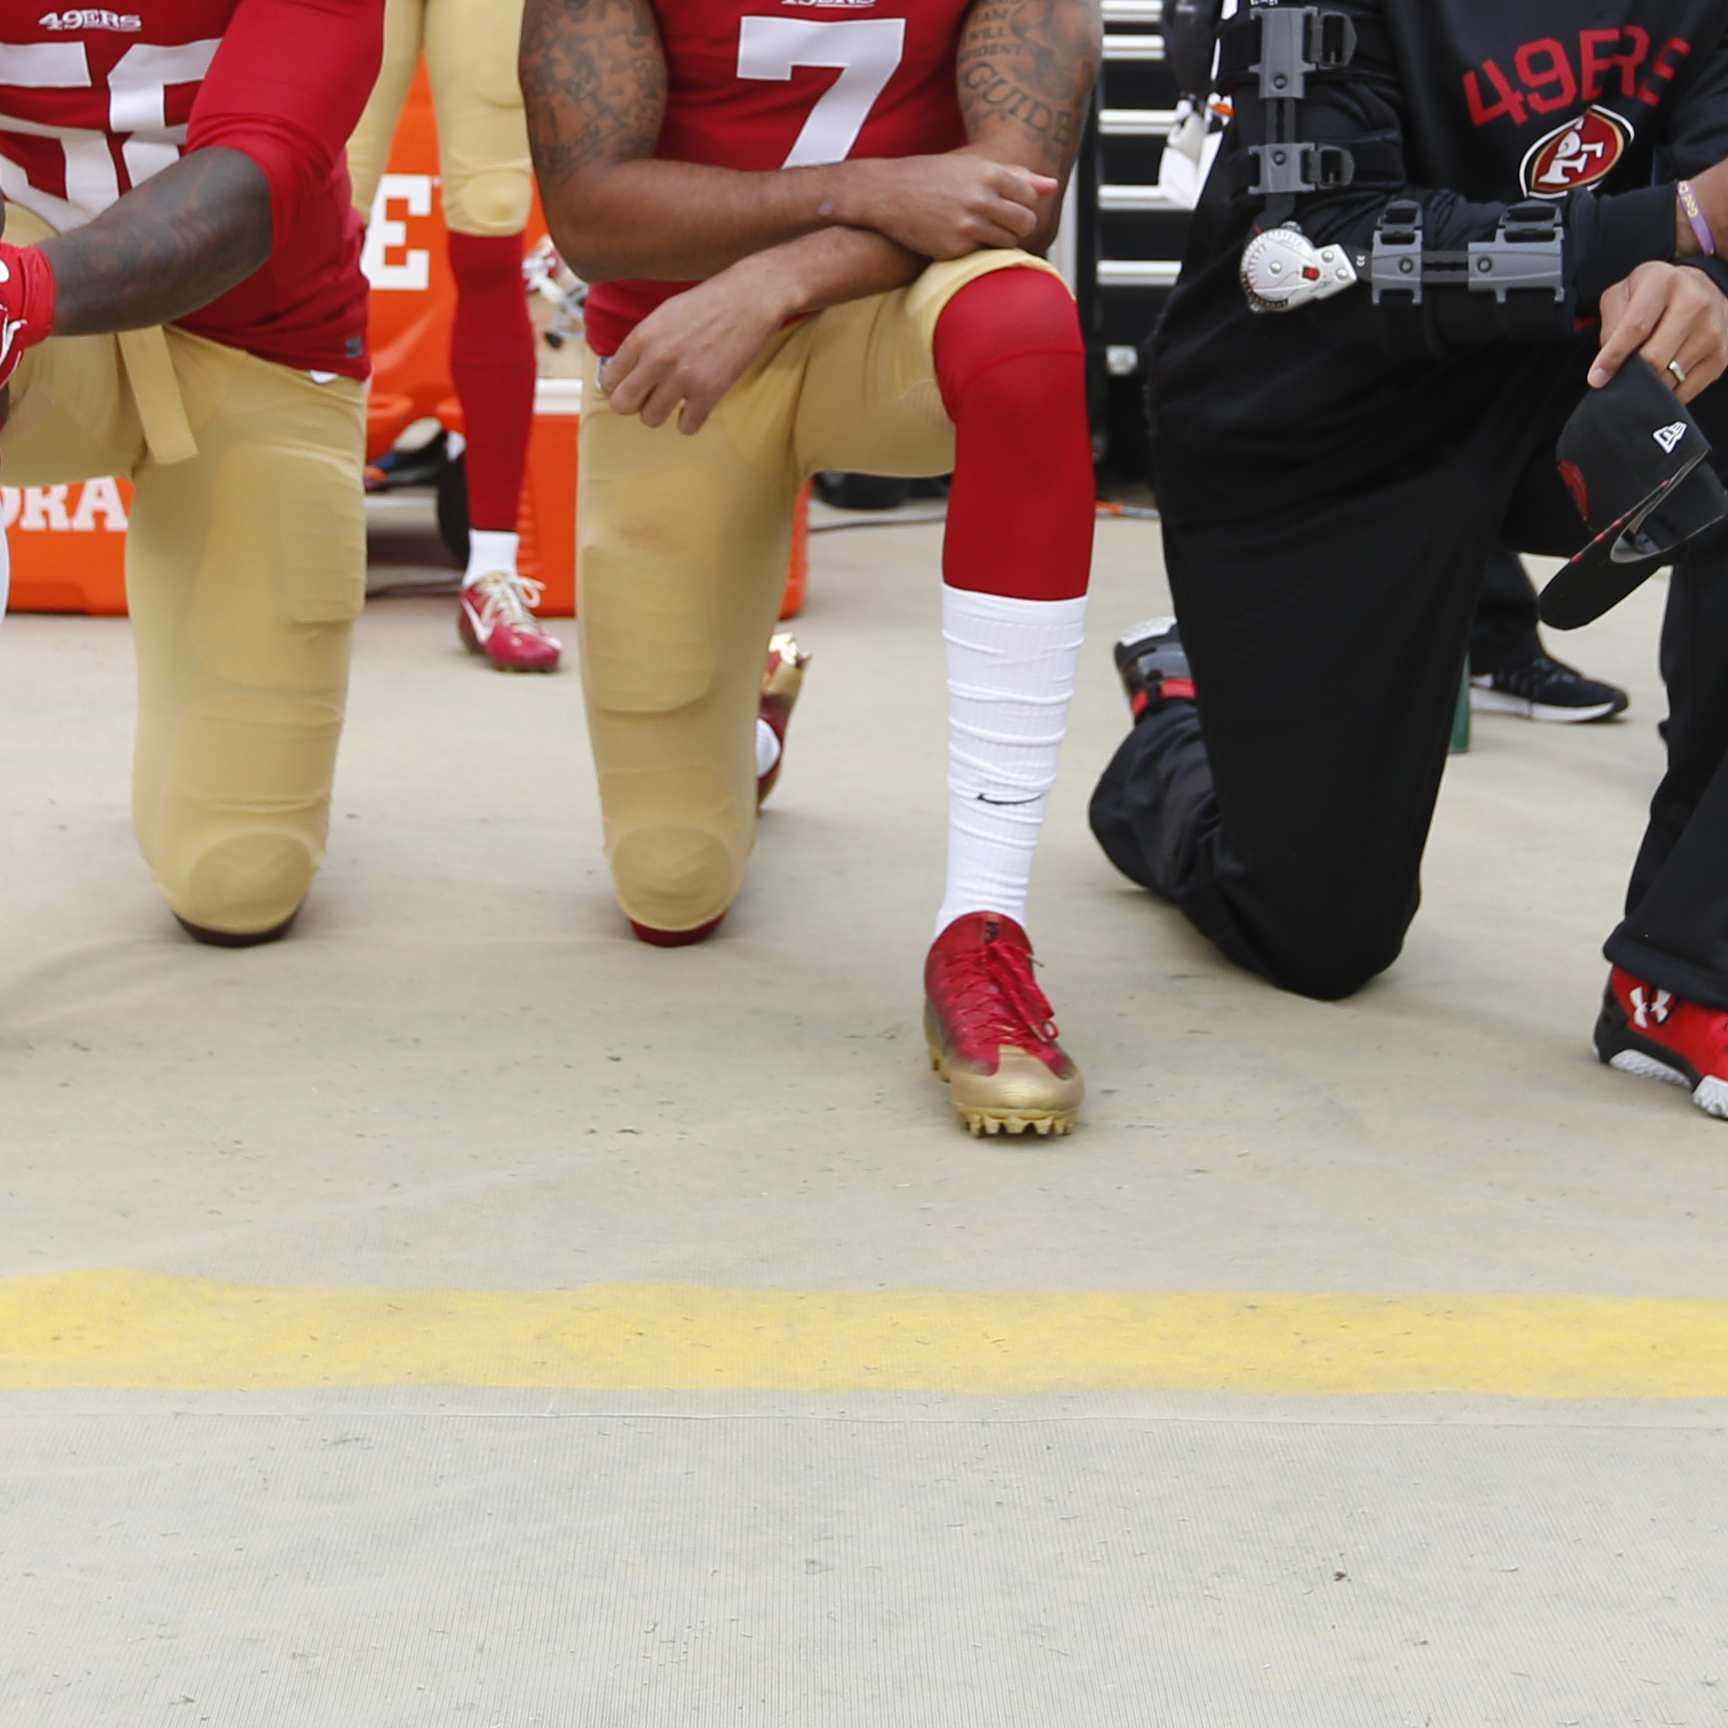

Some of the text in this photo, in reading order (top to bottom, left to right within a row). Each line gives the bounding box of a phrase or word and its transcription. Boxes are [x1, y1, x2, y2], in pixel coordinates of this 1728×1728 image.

[38, 9, 142, 32] 49ERS
[735, 16, 907, 171] 7
[1462, 24, 1691, 126] 49ERS
